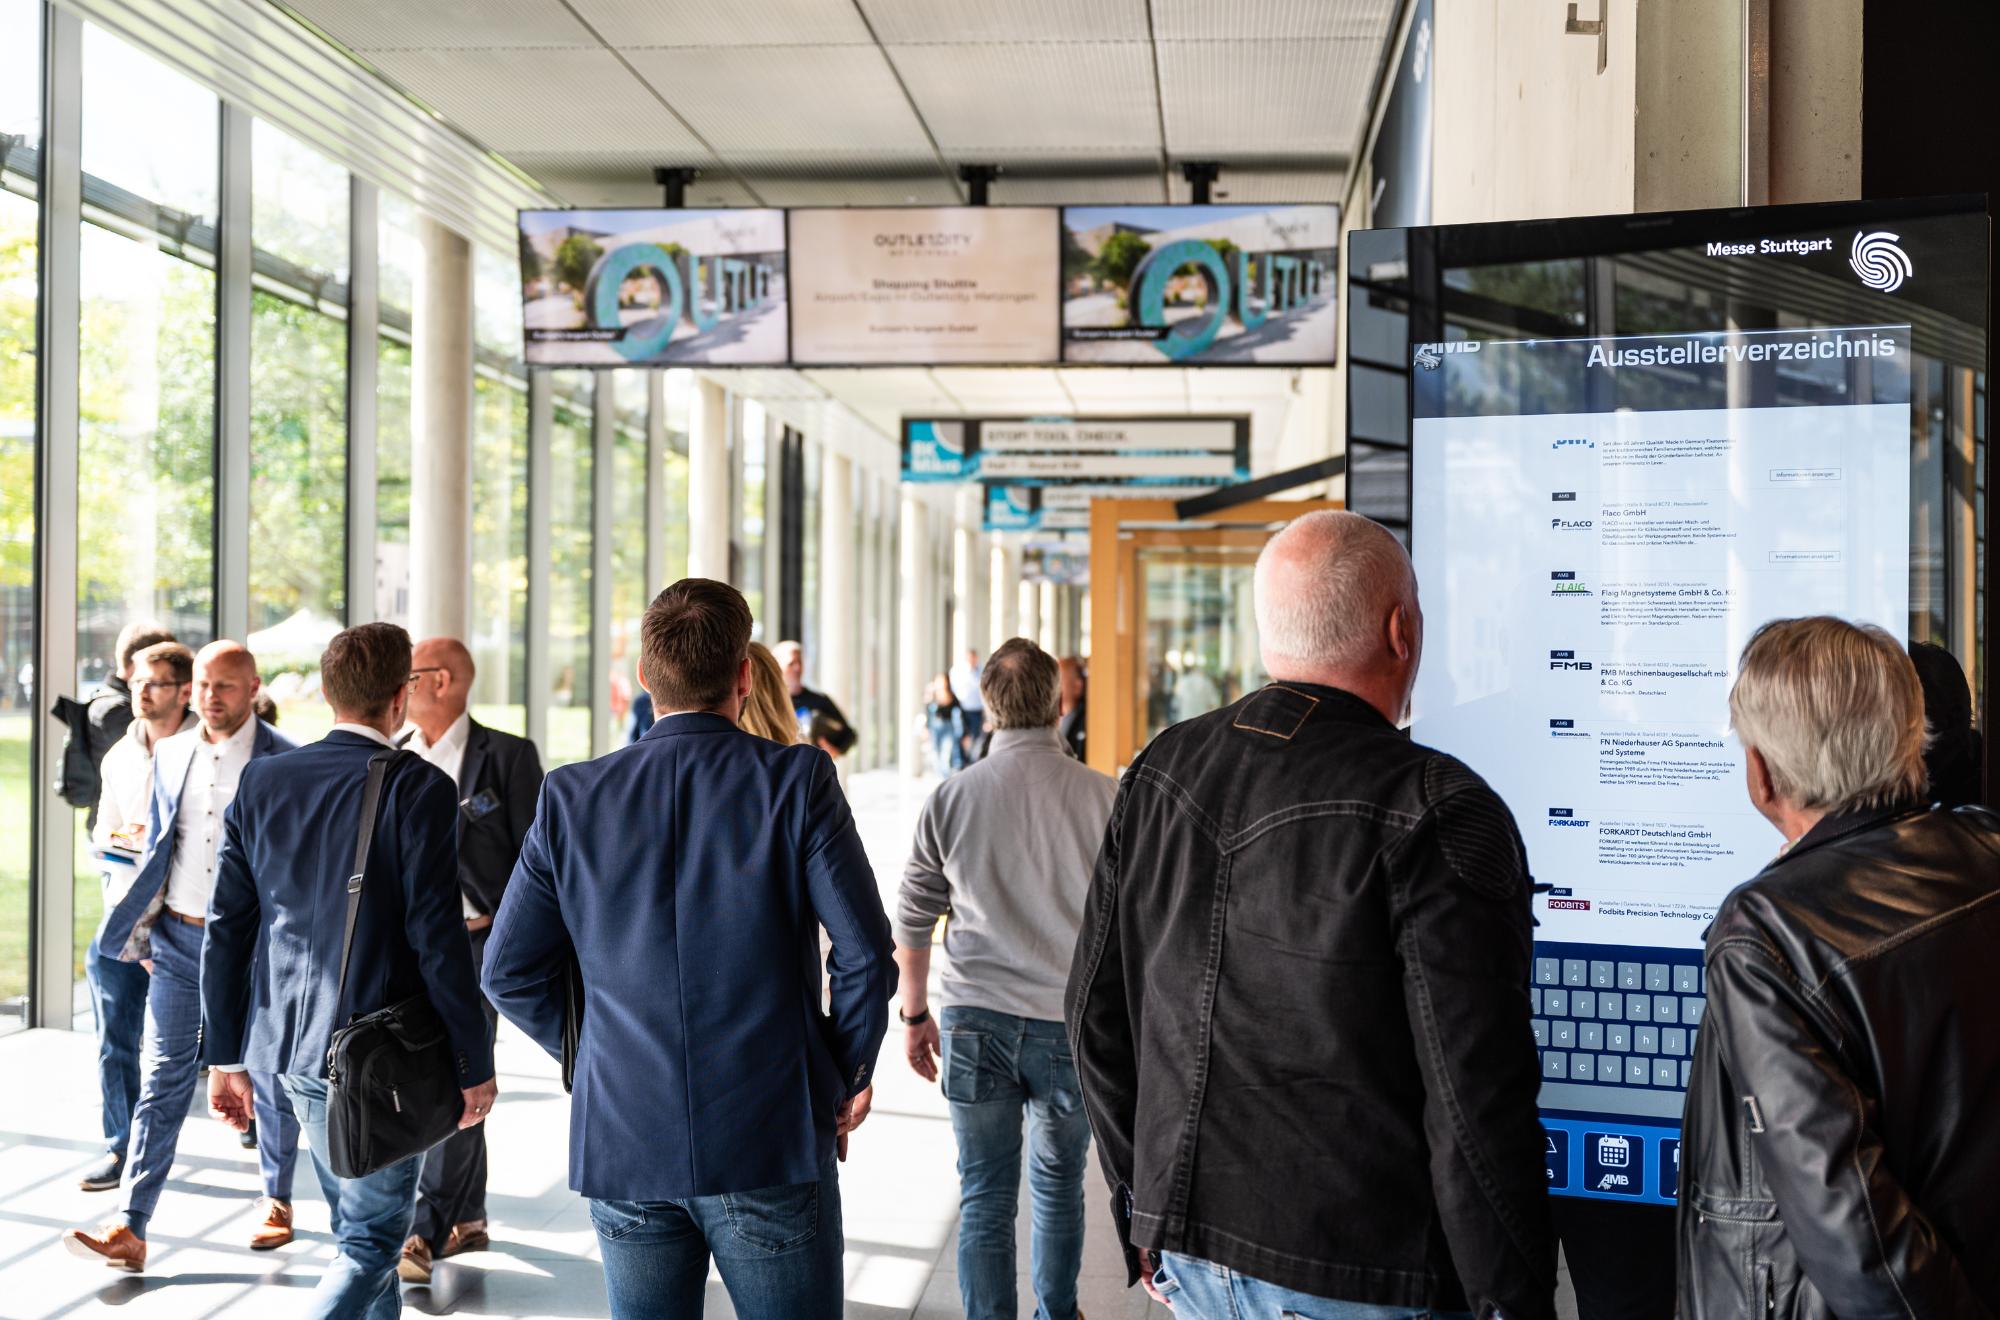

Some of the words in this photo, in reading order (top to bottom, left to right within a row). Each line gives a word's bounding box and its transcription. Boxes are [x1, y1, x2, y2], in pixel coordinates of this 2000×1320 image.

[1707, 242, 1755, 256] Messe
[1760, 238, 1832, 255] Stuttgart
[873, 279, 929, 290] Shopping
[934, 278, 978, 289] Shuttle
[1587, 333, 1896, 367] Ausstellerverzeichnis
[1623, 508, 1647, 516] GmbH
[1561, 520, 1592, 528] FLACO
[1555, 582, 1586, 591] FLAIG
[1601, 589, 1619, 598] Flaig
[1620, 590, 1677, 598] Magnetsysteme
[1678, 589, 1702, 597] GmbH
[1703, 589, 1710, 597] &
[1711, 589, 1724, 597] Co.
[1550, 661, 1593, 671] FMB
[1618, 669, 1712, 679] Maschinenbaugesellschaft
[1600, 738, 1611, 746] FN
[1612, 738, 1661, 747] Niederhauser
[1661, 739, 1674, 747] AG
[1675, 739, 1725, 749] Spanntechnik
[1615, 748, 1646, 757] Systeme
[1548, 819, 1591, 827] FORKARDT
[1599, 828, 1640, 836] FORKARDT
[1641, 829, 1687, 838] Deutschland
[1688, 830, 1712, 839] GmbH
[1599, 907, 1625, 916] Fodbits
[1626, 909, 1659, 917] Precision
[1660, 910, 1701, 921] Technology
[1544, 973, 1551, 981] 3
[1572, 974, 1578, 982] 4
[1599, 976, 1605, 984] 5
[1654, 979, 1660, 987] 7
[1581, 1001, 1586, 1009] r
[1608, 1002, 1613, 1011] t
[1635, 1005, 1641, 1013] z
[1661, 1006, 1668, 1014] u
[1692, 1006, 1696, 1015] i
[1560, 1030, 1567, 1039] d
[1589, 1031, 1594, 1041] f
[1615, 1035, 1622, 1044] g
[1643, 1035, 1650, 1044] h
[1671, 1036, 1675, 1048] j
[1552, 1062, 1559, 1070] x
[1606, 1065, 1613, 1073] v
[1634, 1066, 1641, 1075] b
[1661, 1069, 1668, 1077] n
[1601, 1173, 1629, 1186] AMB
